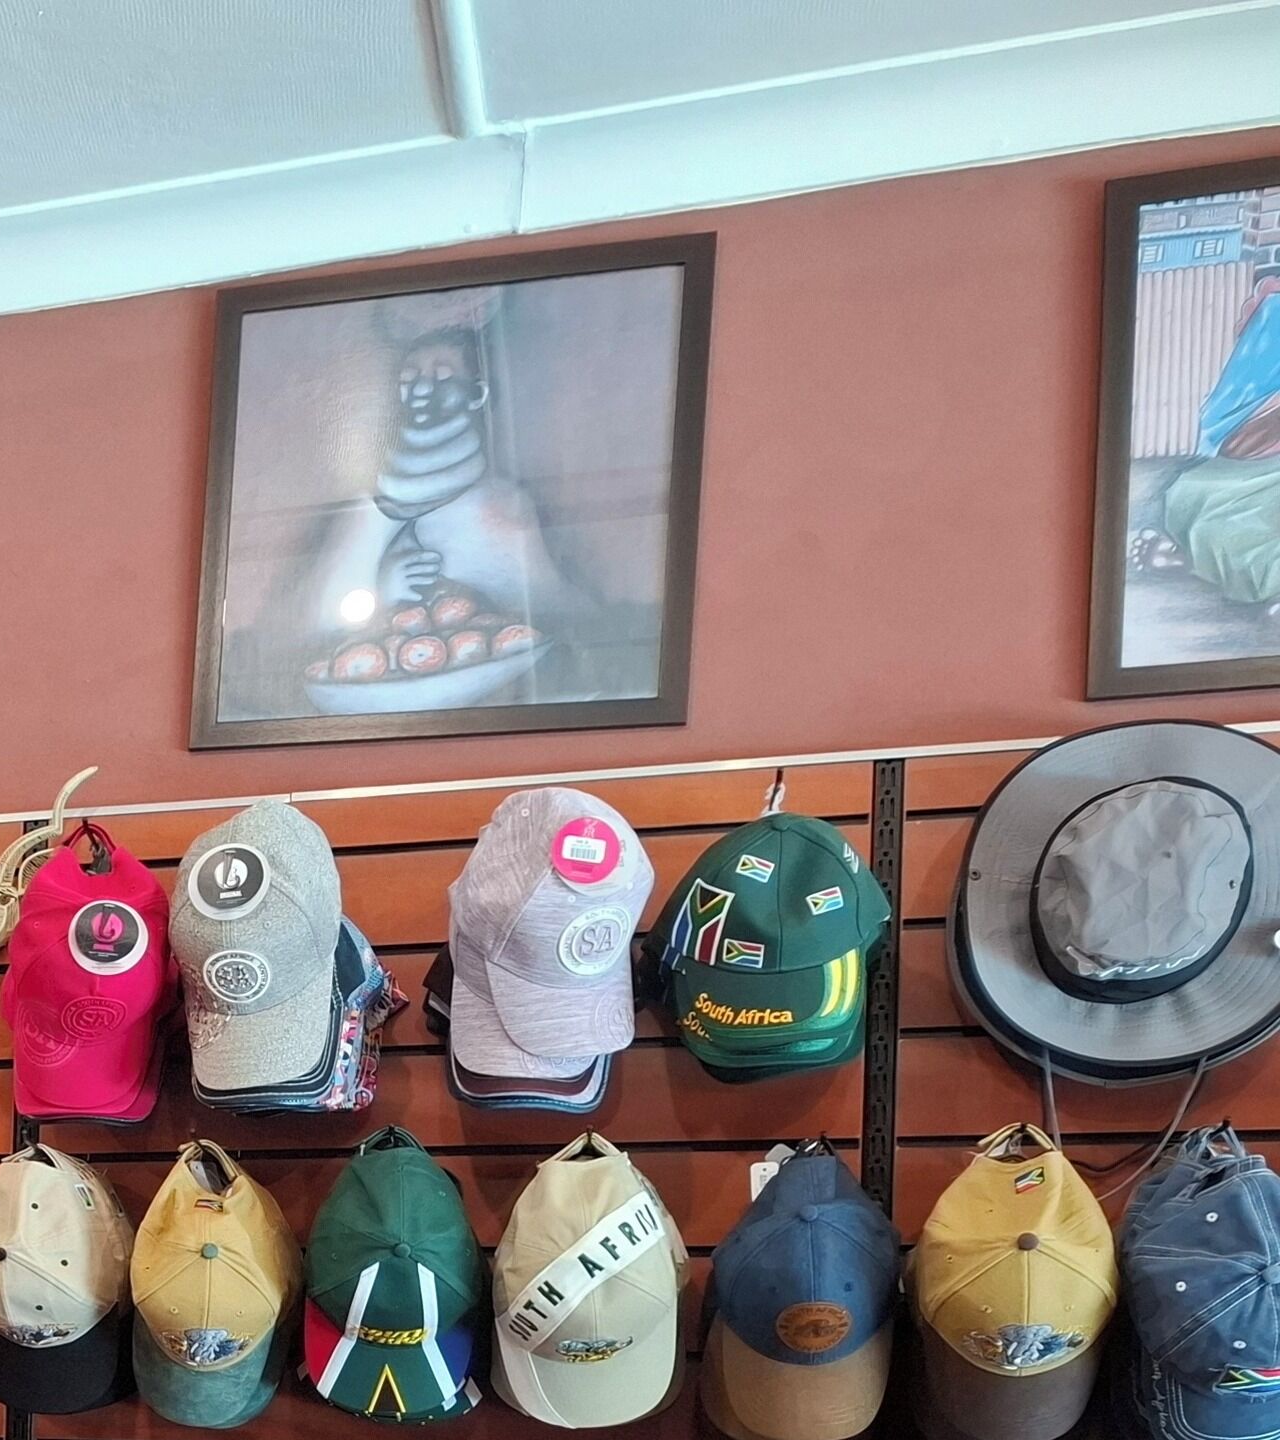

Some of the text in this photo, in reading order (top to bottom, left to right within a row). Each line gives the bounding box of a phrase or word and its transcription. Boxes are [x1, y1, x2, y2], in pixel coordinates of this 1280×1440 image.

[580, 922, 615, 957] SA
[695, 993, 793, 1026] South Africa
[682, 1011, 713, 1042] Sou
